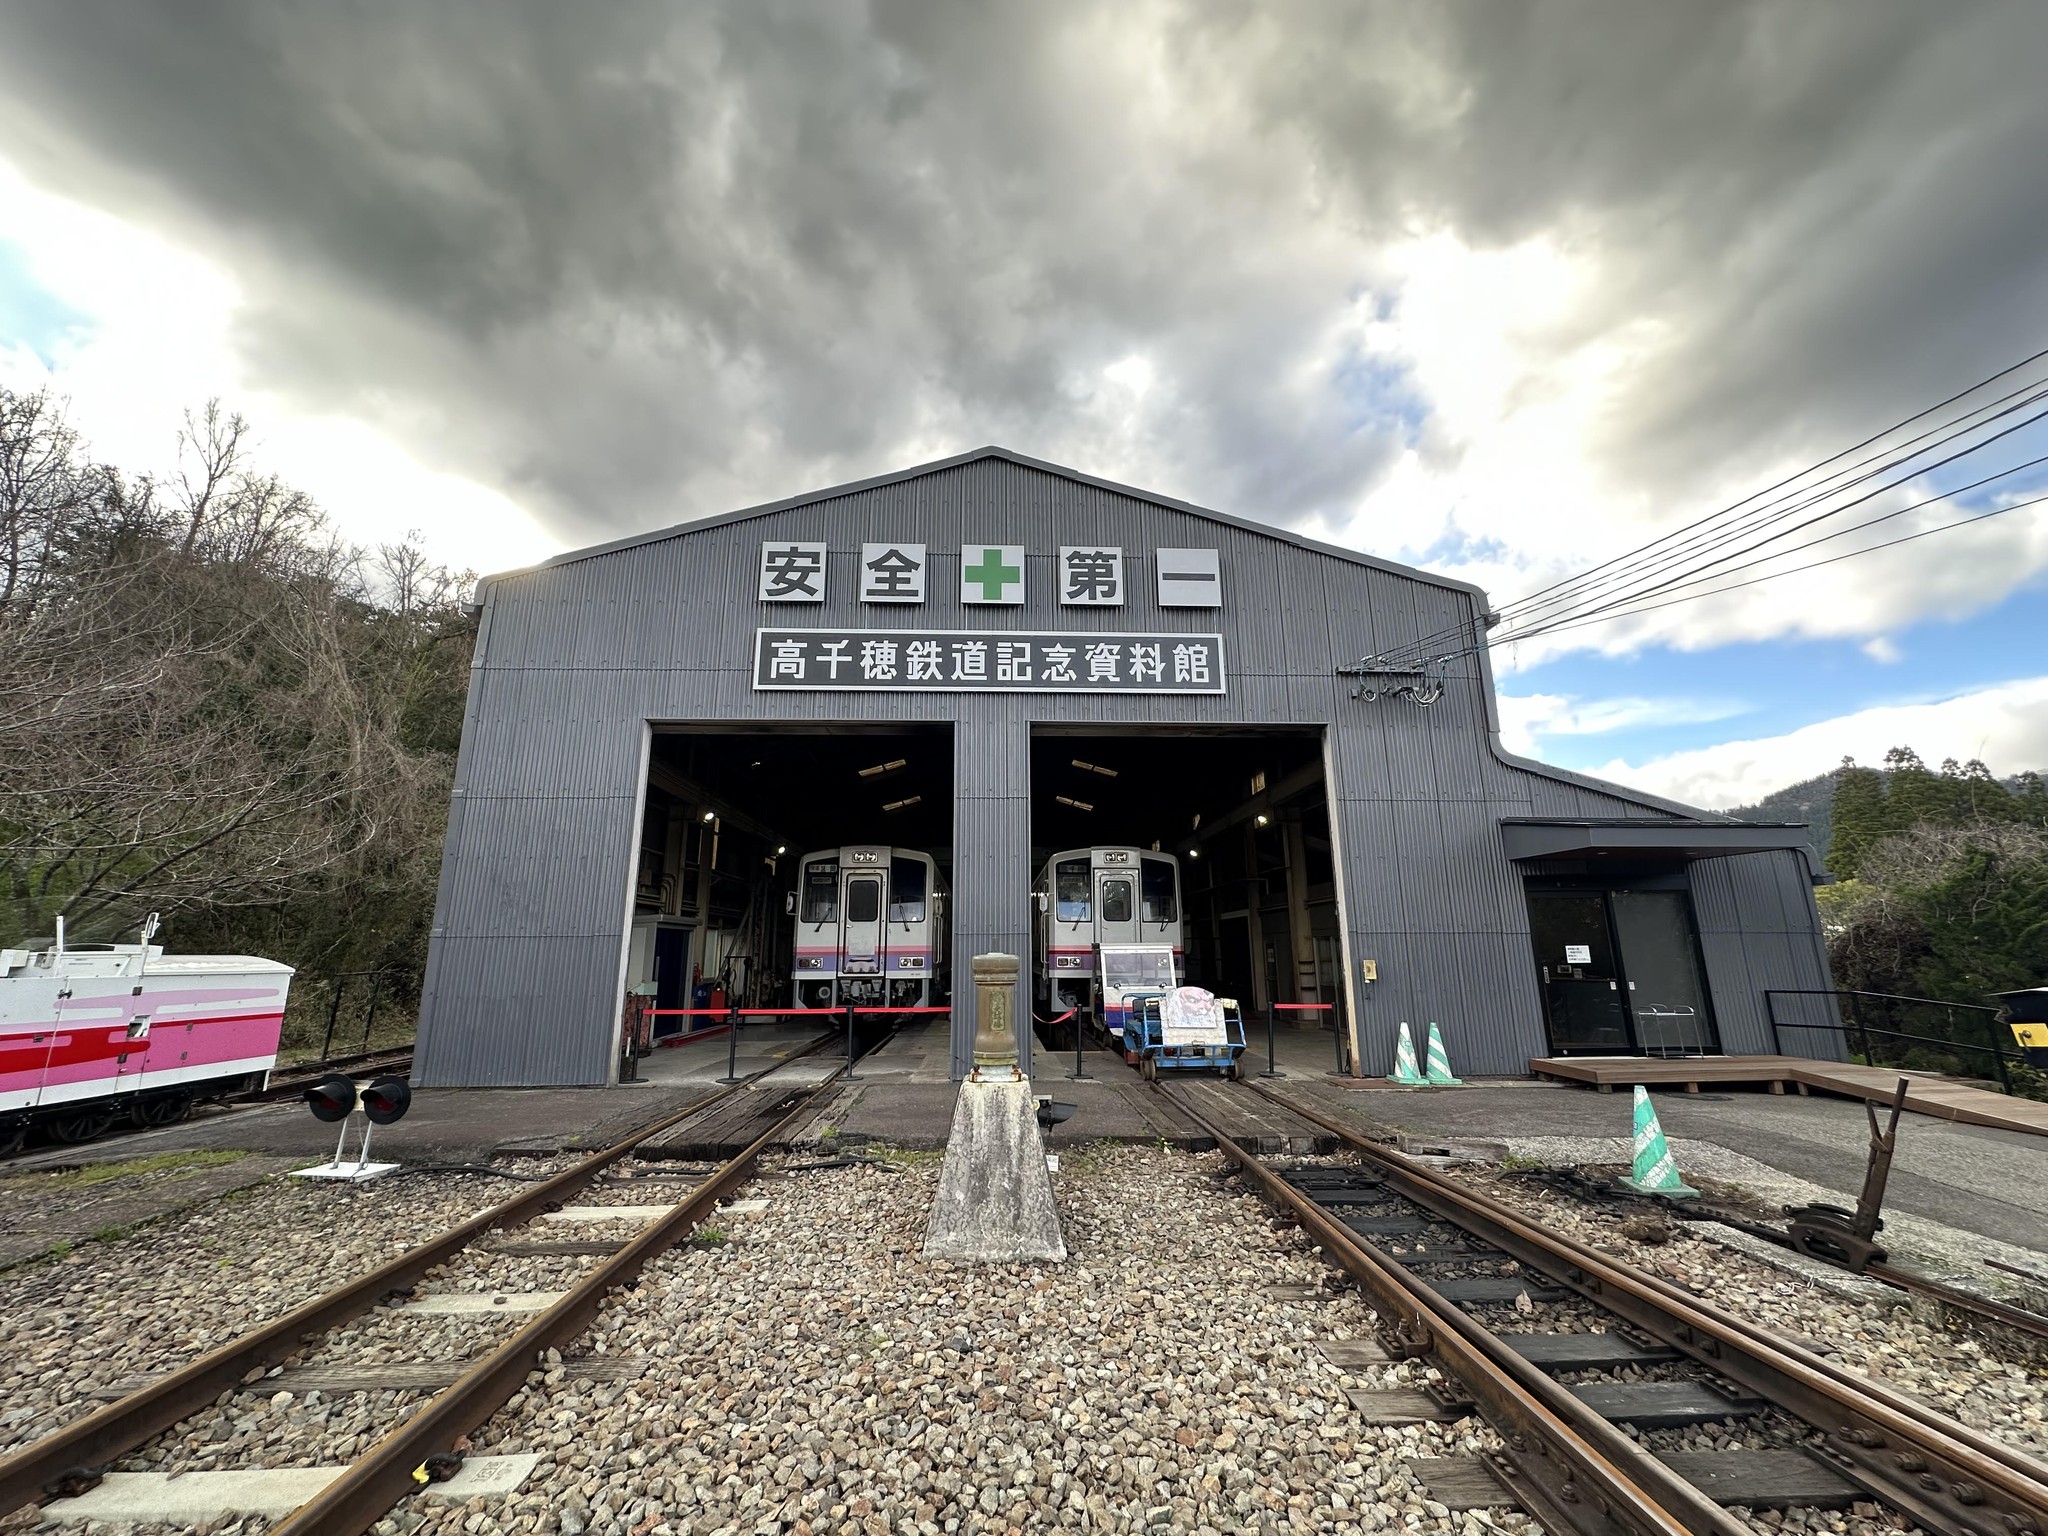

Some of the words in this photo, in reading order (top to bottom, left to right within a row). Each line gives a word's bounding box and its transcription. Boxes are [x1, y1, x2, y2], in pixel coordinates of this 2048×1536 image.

[770, 637, 1212, 683] 高千穂鉄道記念資料館
